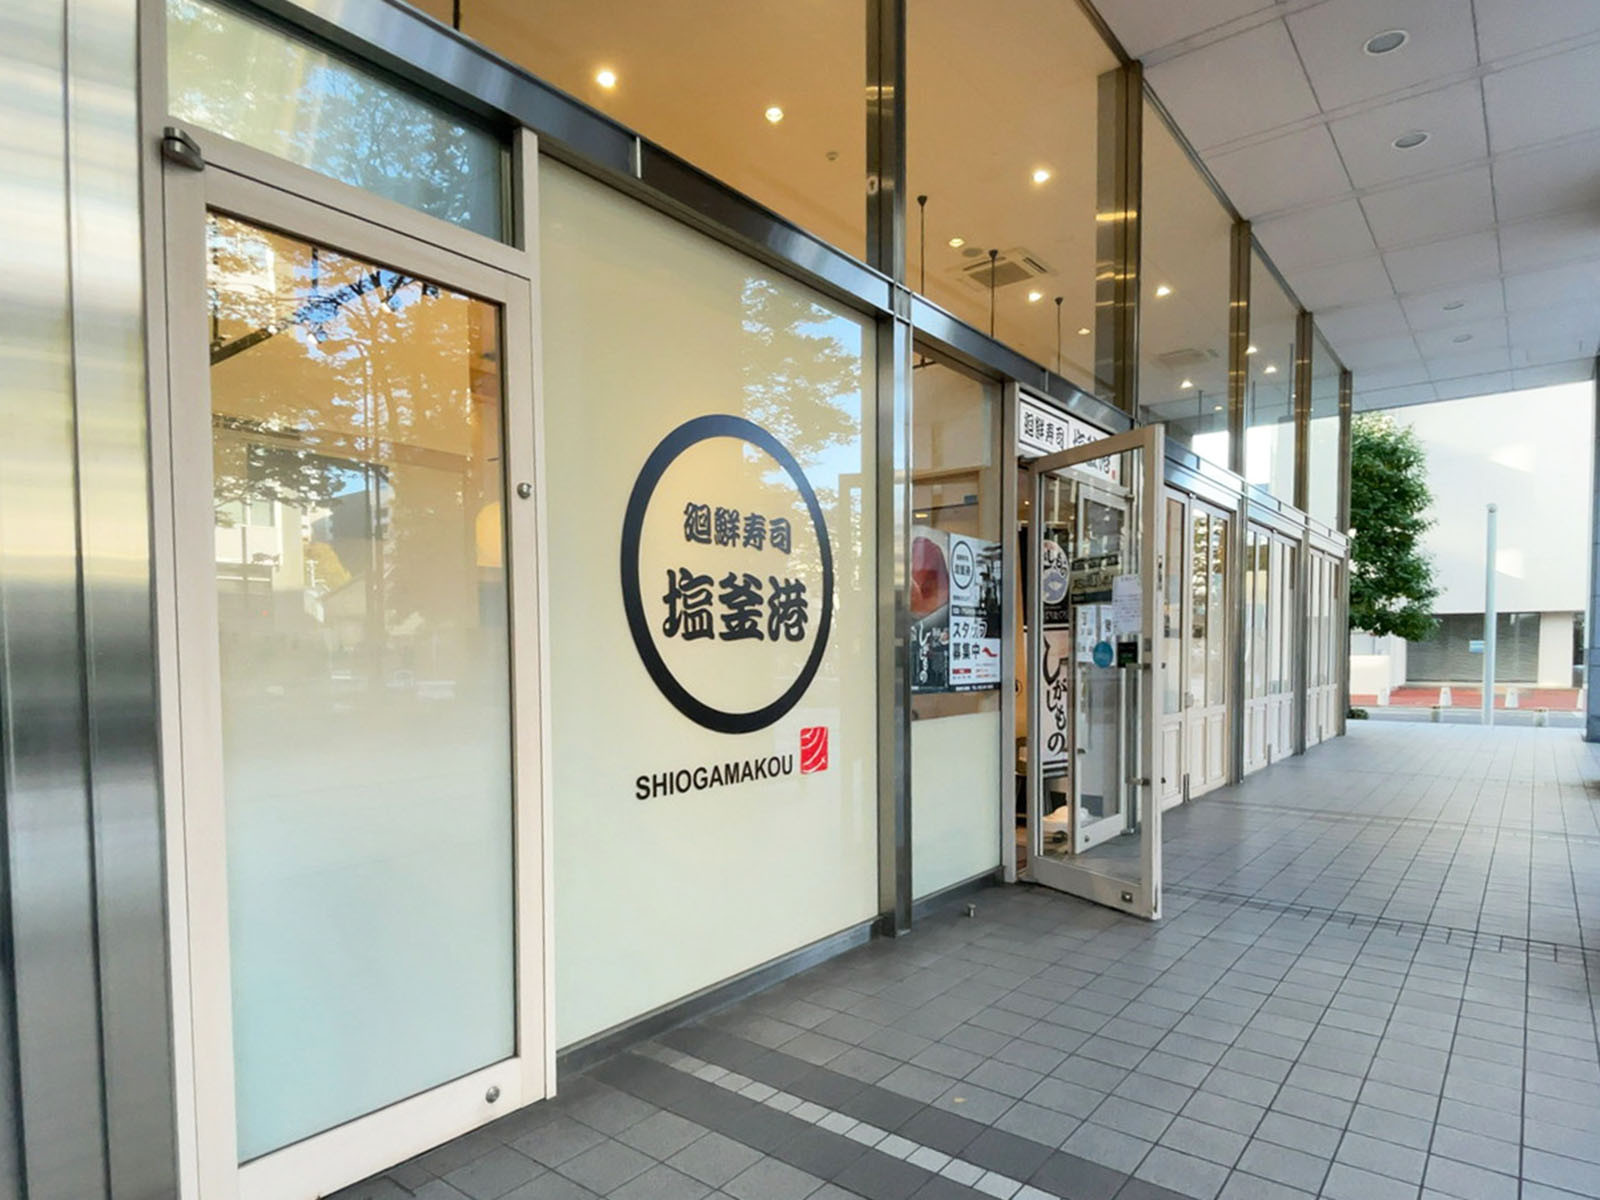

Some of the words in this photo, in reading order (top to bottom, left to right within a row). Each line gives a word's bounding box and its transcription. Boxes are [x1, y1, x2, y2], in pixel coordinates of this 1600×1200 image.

[683, 502, 792, 554] 廻鮮寿司
[662, 567, 809, 643] 塩釜港
[953, 642, 980, 660] 募集中
[635, 754, 793, 801] SHIOGAMAKOU
